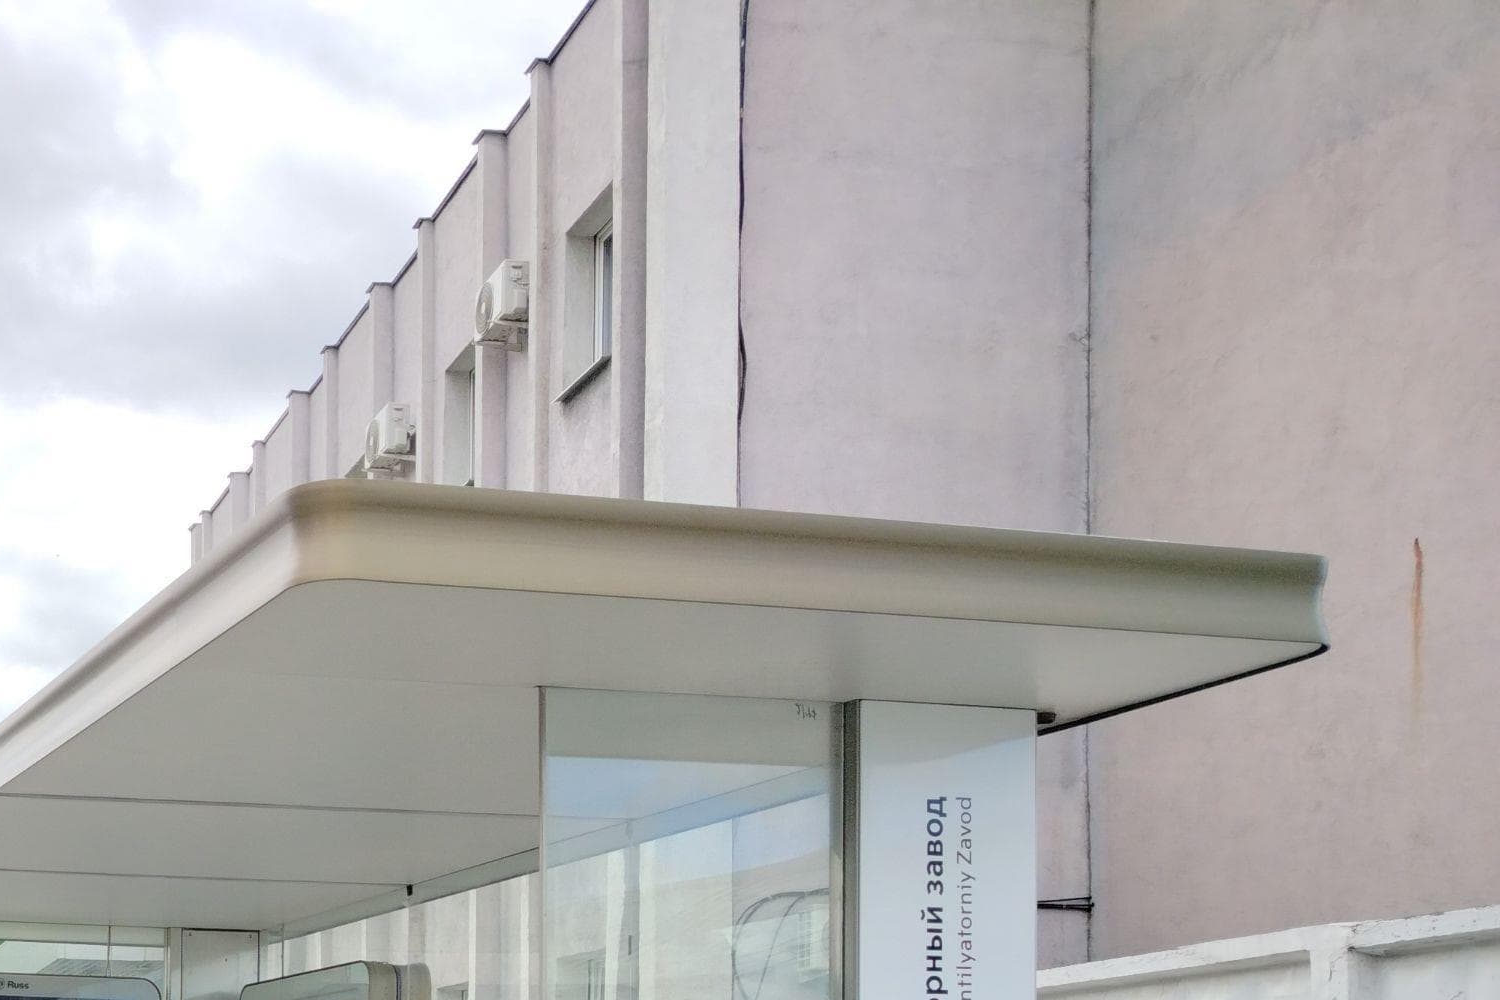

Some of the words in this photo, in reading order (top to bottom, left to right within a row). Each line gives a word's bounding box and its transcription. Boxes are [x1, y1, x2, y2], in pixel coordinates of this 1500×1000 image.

[926, 796, 947, 895] завод
[956, 796, 973, 864] Zavod
[7, 980, 29, 989] Russ
